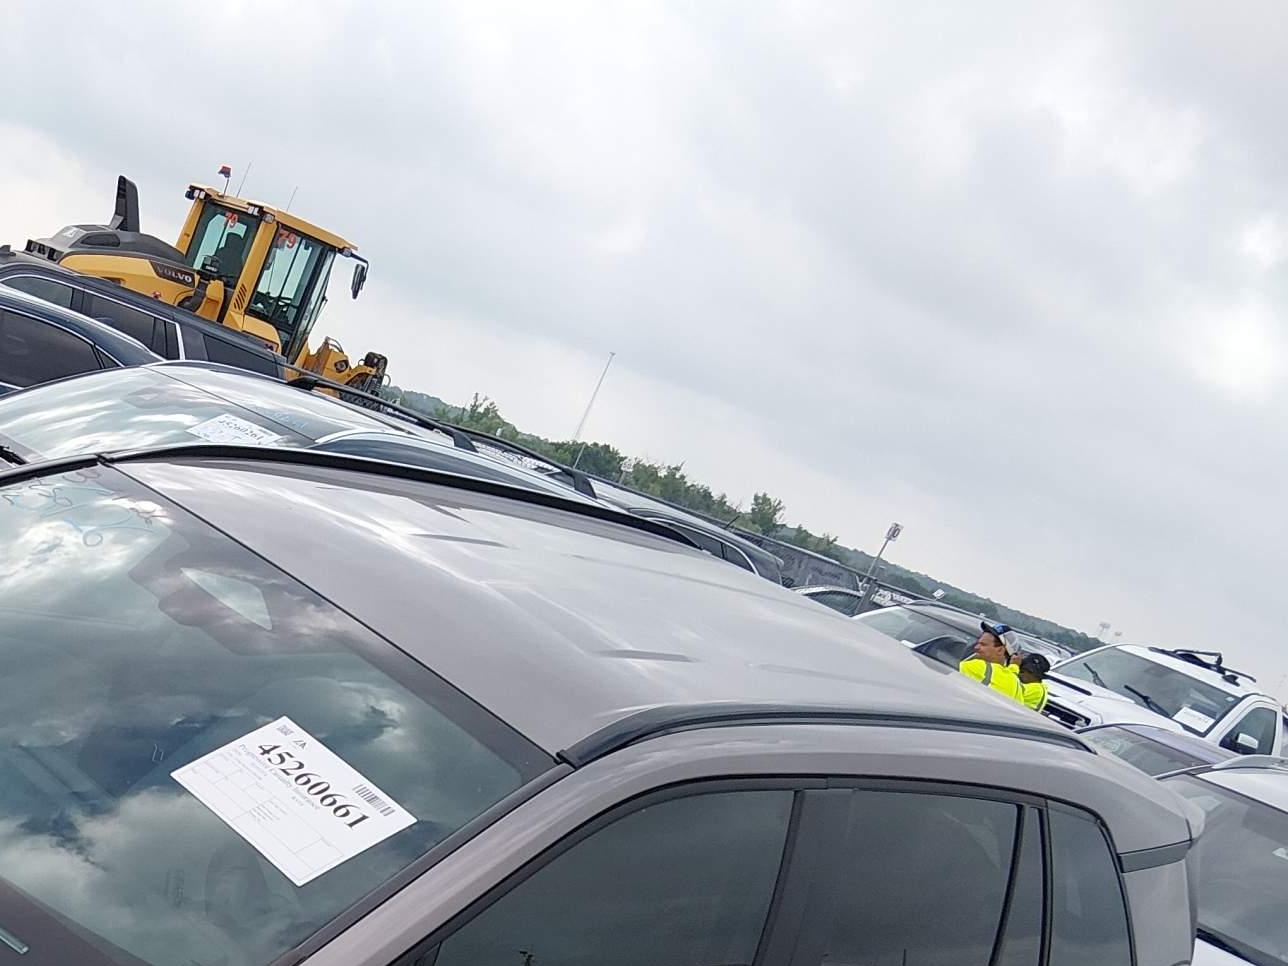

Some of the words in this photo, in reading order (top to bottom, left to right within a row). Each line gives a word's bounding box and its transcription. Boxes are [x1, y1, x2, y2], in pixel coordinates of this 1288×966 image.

[224, 211, 239, 228] 79
[277, 228, 297, 248] 79
[156, 265, 192, 283] VOLVO
[258, 742, 371, 829] 45260661
